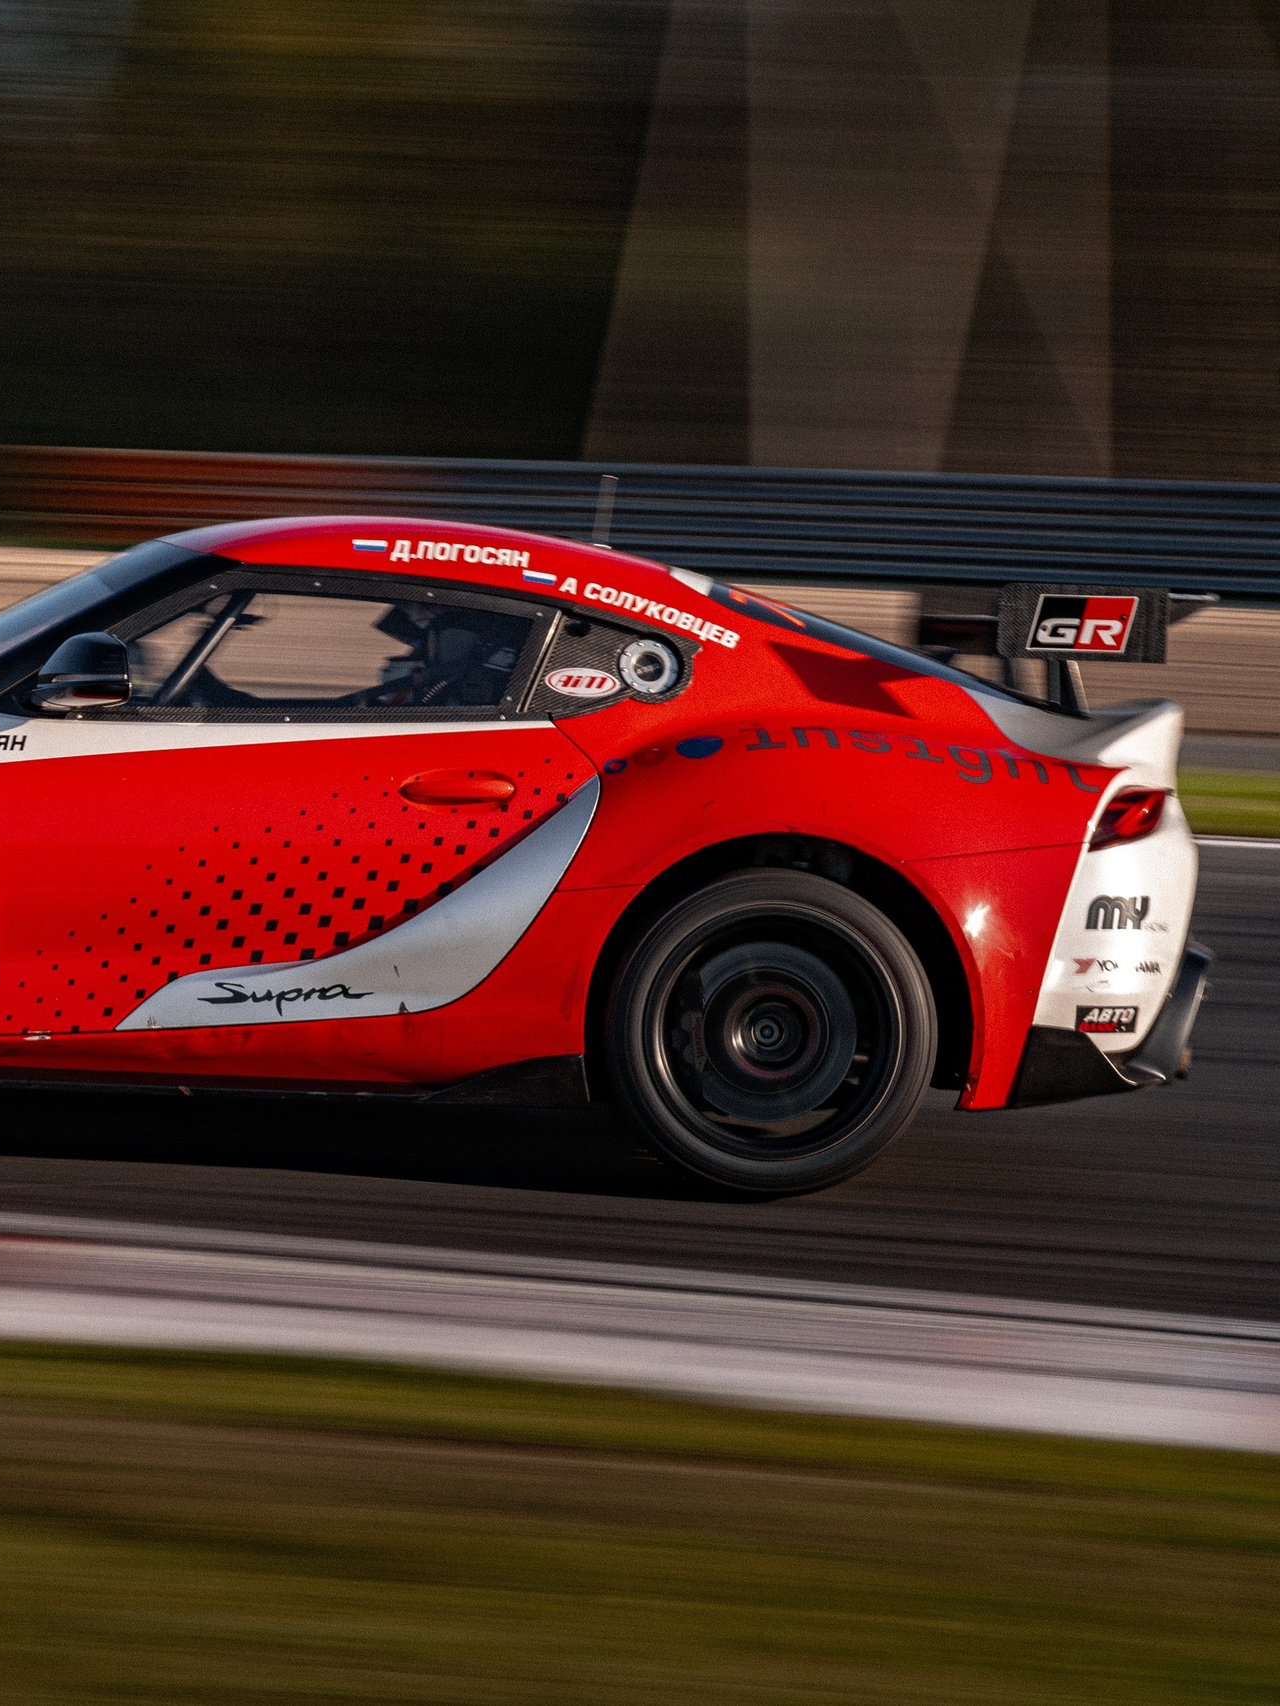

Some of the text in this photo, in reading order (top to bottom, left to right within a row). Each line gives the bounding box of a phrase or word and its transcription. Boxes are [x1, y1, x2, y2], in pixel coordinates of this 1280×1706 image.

[390, 539, 530, 568] Д.ПОГОСЯН
[583, 582, 741, 650] СОЛУКОВЦЕВ
[1036, 617, 1124, 646] GR
[196, 981, 375, 1017] Supra
[1083, 1007, 1136, 1024] АВТО
